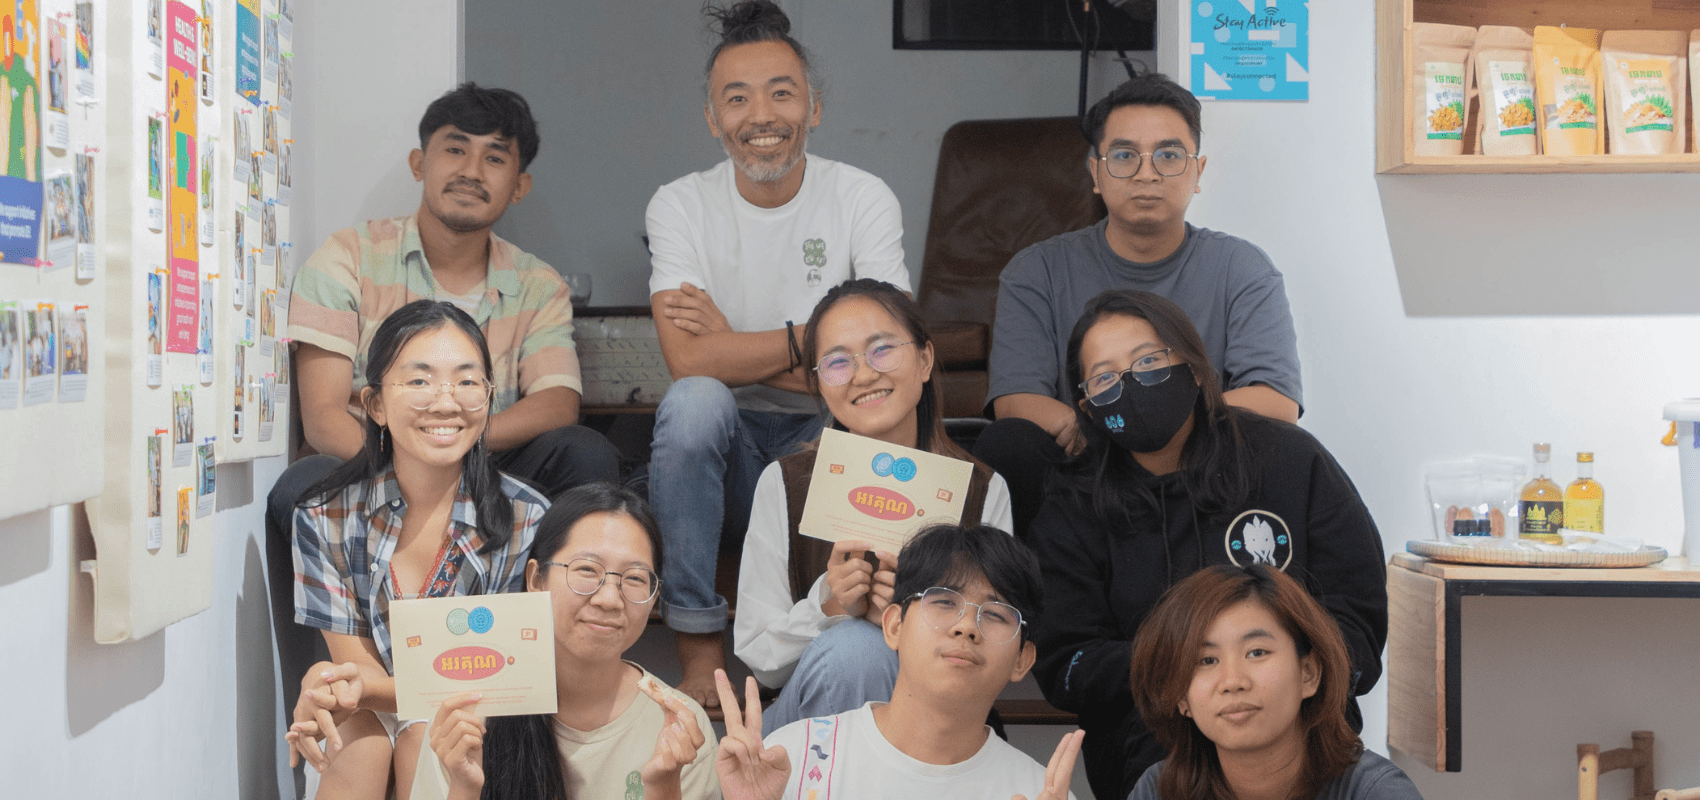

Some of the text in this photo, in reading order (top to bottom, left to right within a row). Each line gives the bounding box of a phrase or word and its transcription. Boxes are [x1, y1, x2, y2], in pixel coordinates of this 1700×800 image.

[1213, 12, 1286, 31] Stay Active
[855, 491, 909, 515] អរគុណ
[441, 654, 497, 675] អរគុណ
